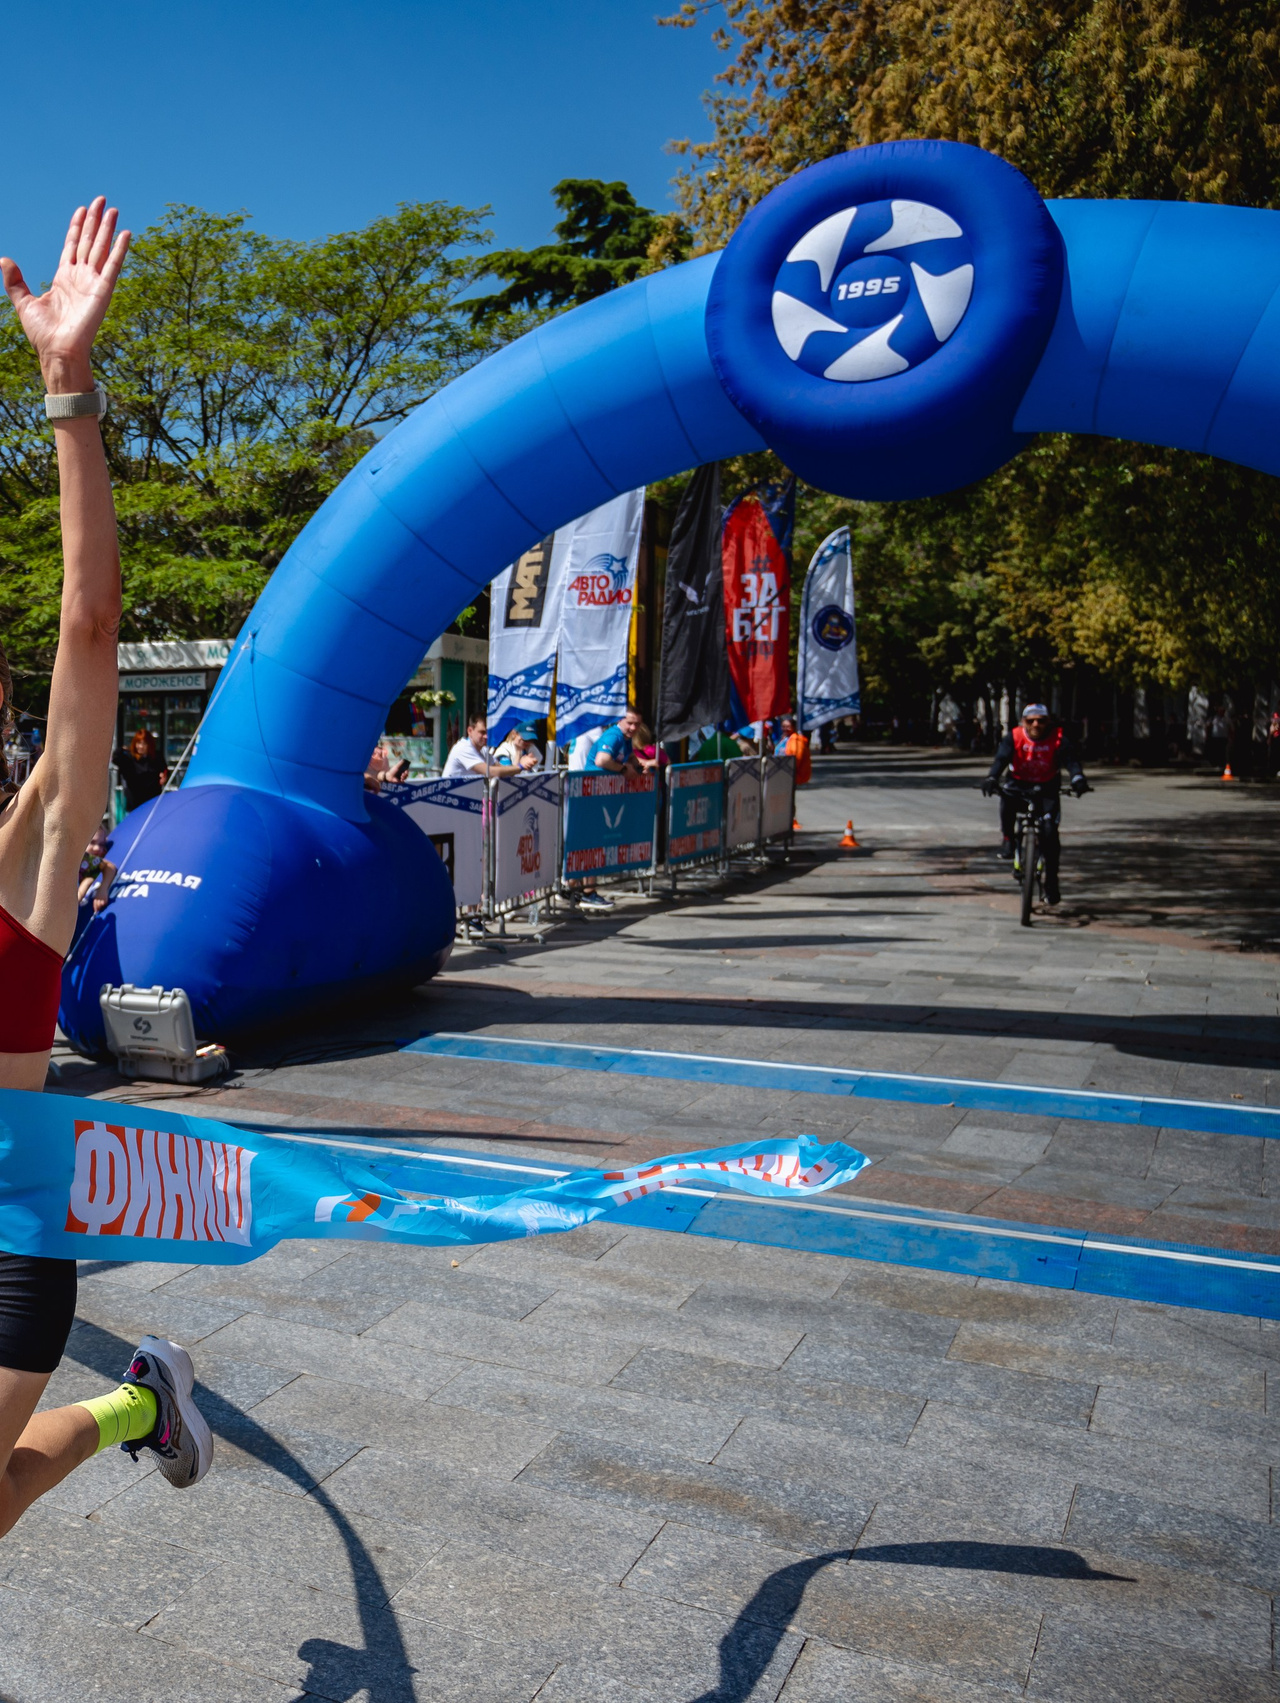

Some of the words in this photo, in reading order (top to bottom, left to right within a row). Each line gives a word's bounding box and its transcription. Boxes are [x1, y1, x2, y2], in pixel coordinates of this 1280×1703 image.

[838, 276, 901, 301] 1995
[568, 575, 610, 592] АВТО
[740, 572, 780, 608] ЗА
[577, 588, 632, 606] РАДИО
[732, 606, 786, 642] БЕГ
[124, 675, 202, 689] МОРОЖЕНОЕ
[411, 780, 452, 800] ЗАБЕГ.РФ
[120, 869, 202, 890] ЫСШАЯ
[109, 884, 149, 898] ИГА
[70, 1121, 258, 1247] ФИНИШ
